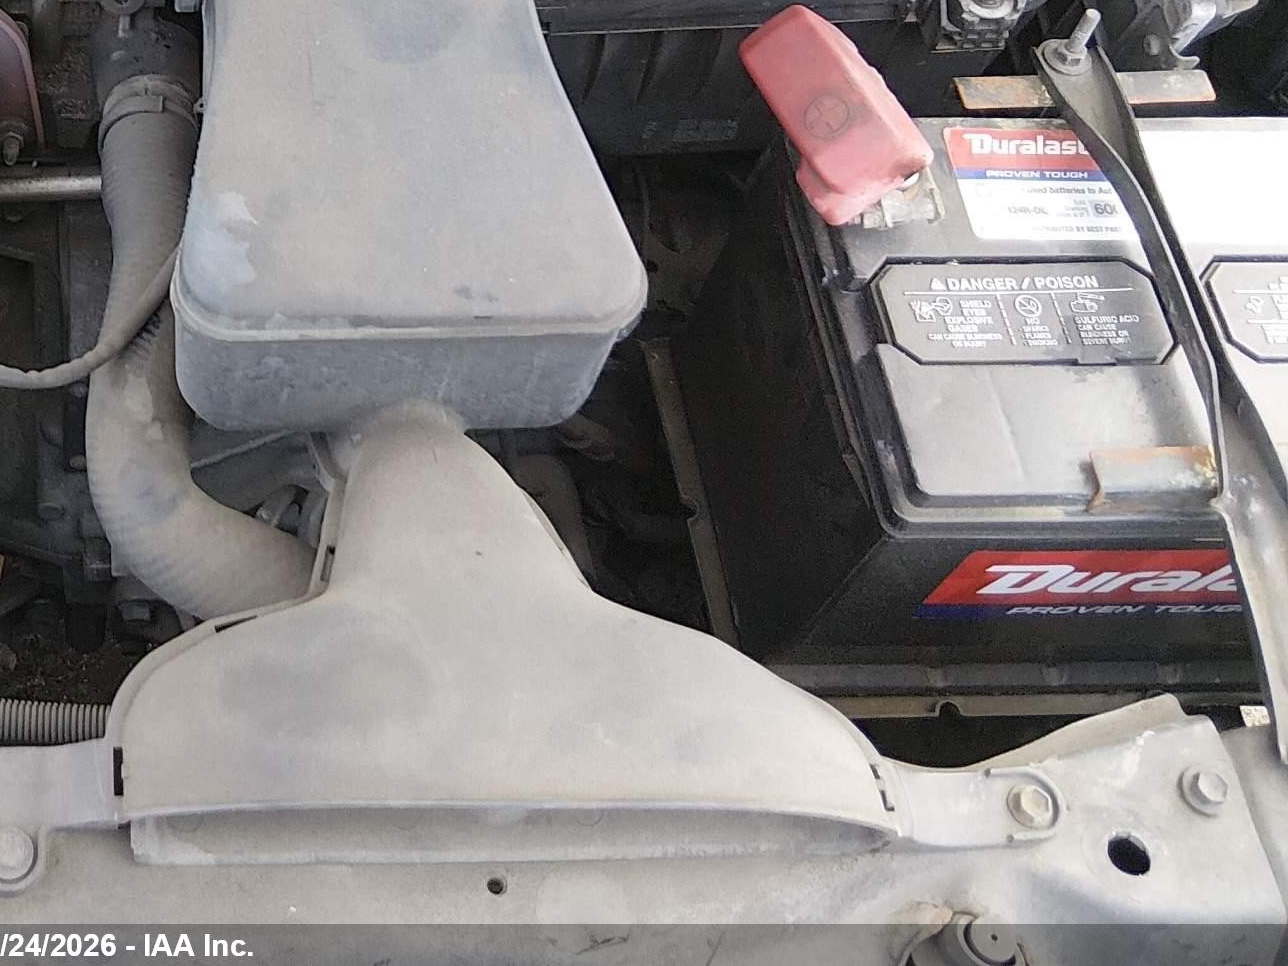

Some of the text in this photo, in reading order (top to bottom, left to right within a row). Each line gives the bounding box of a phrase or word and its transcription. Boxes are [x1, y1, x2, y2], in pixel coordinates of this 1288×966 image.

[985, 170, 1089, 179] PROVEN TOUGH
[1049, 187, 1086, 195] batteries
[946, 277, 1018, 291] DANGER
[1033, 275, 1100, 289] POISON
[960, 300, 992, 308] SHIELD
[1025, 317, 1040, 325] NO
[1074, 315, 1140, 325] SULFURIC ACID
[1006, 605, 1143, 615] PROVEN
